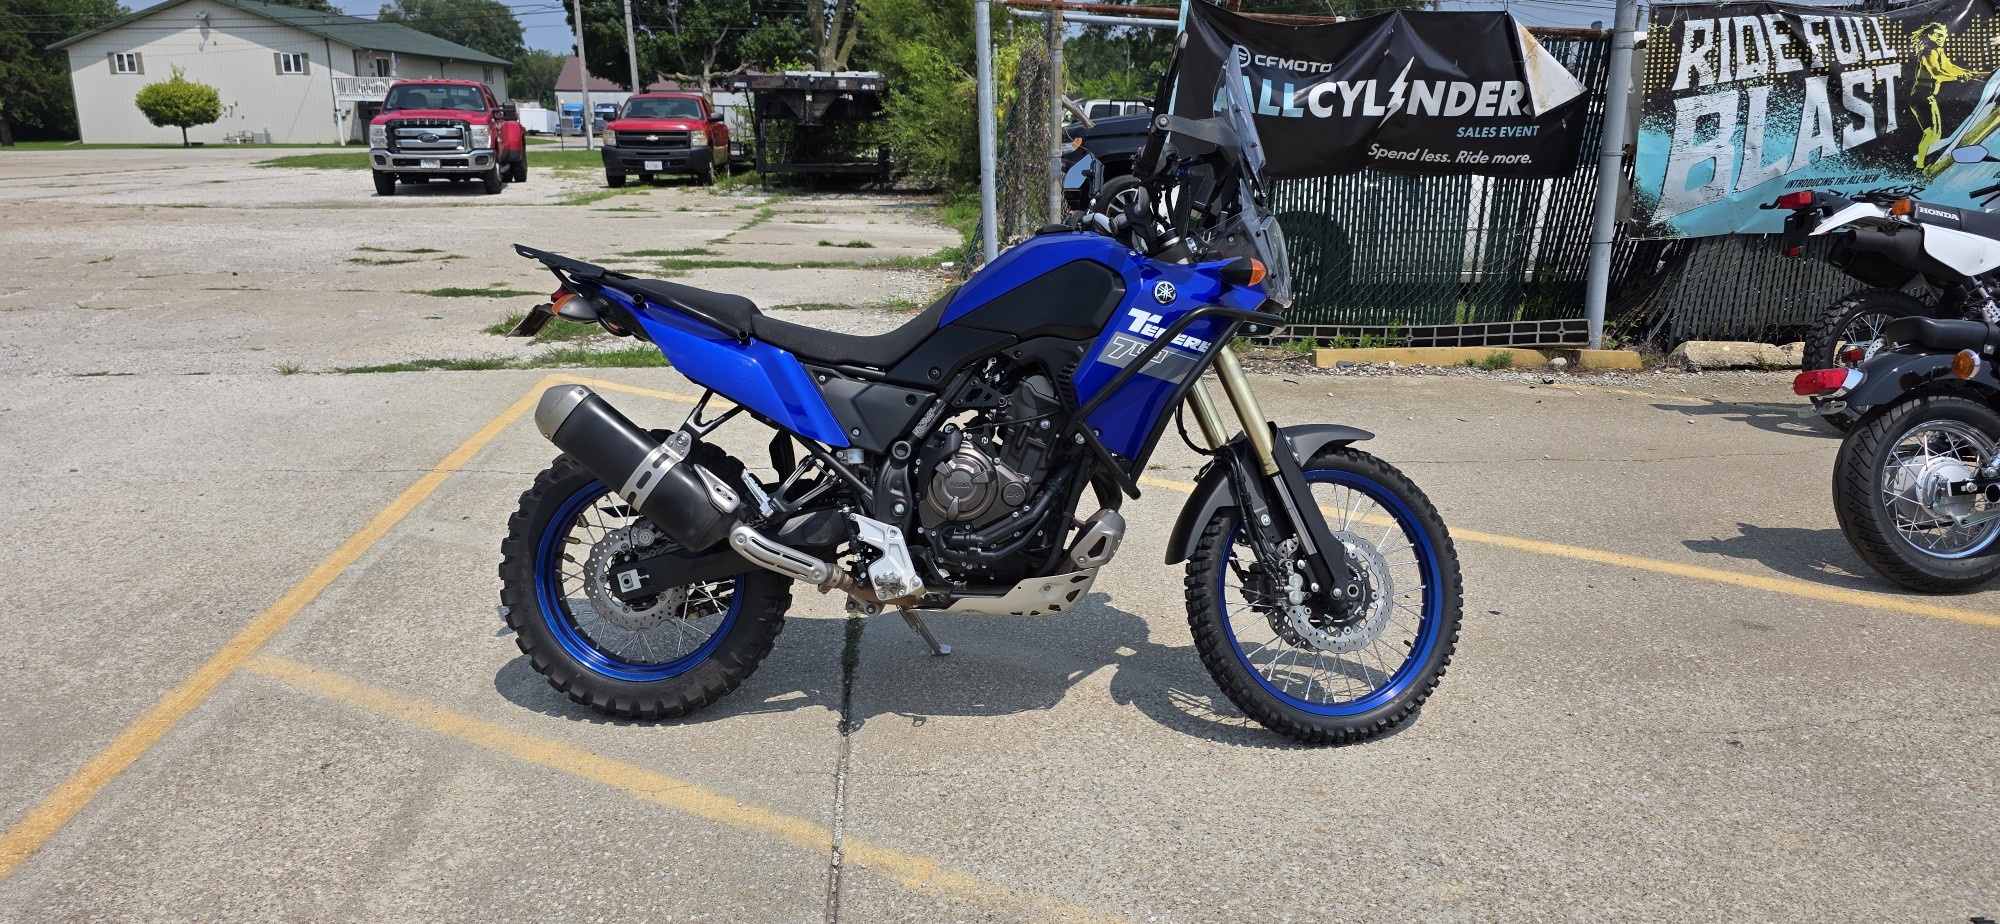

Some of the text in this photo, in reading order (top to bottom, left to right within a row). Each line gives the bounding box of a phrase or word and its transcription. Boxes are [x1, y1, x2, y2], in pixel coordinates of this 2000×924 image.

[1672, 13, 1898, 90] RIDE FULL
[1254, 54, 1333, 73] CFMOTO
[1456, 125, 1540, 138] SALES EVENT
[1367, 143, 1533, 164] Spend less. Ride more.
[1650, 63, 1902, 226] BLAST
[1784, 173, 1880, 189] INTRODUCING THE ALL-NEW
[1918, 206, 1960, 221] HONDA
